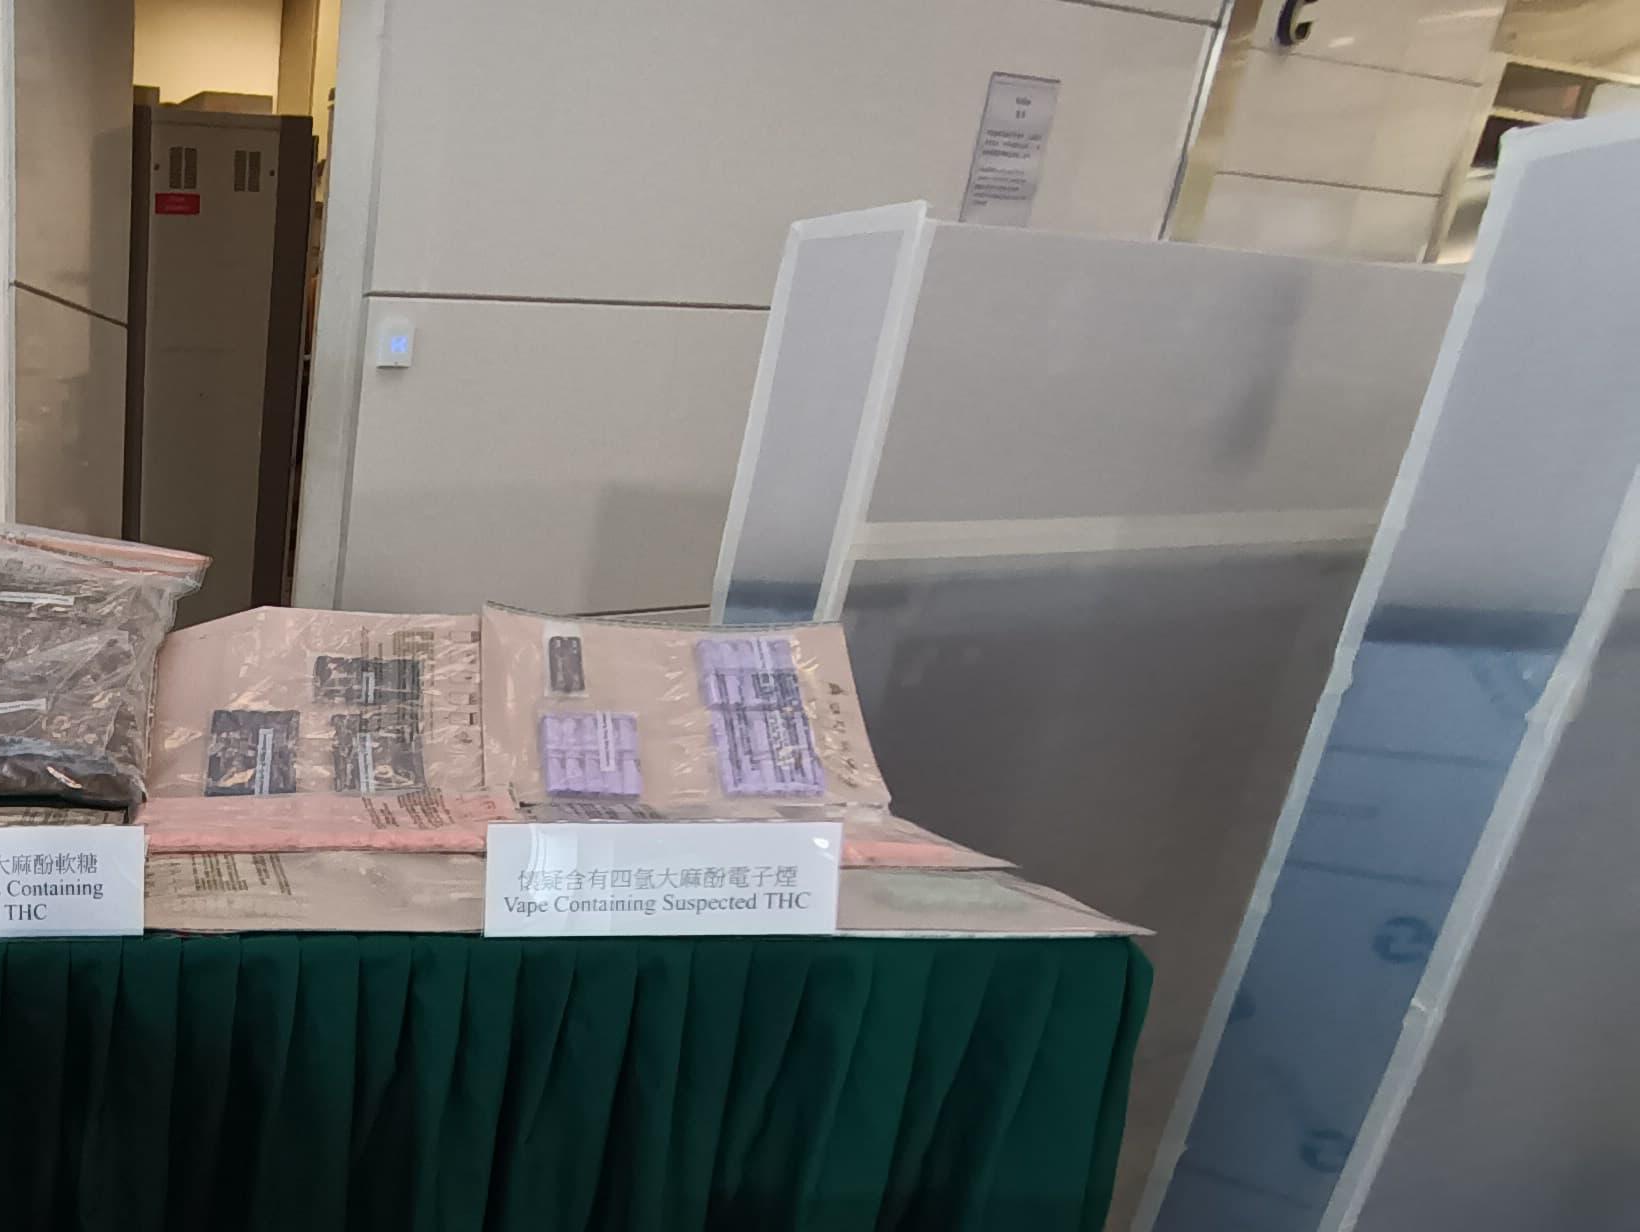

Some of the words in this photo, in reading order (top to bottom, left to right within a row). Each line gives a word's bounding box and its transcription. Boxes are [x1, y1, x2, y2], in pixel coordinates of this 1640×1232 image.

[6, 879, 104, 898] Containing
[4, 904, 48, 921] THC
[504, 896, 549, 916] Vape
[553, 895, 657, 915] Containing
[661, 893, 757, 914] Suspected
[763, 892, 811, 910] THC
